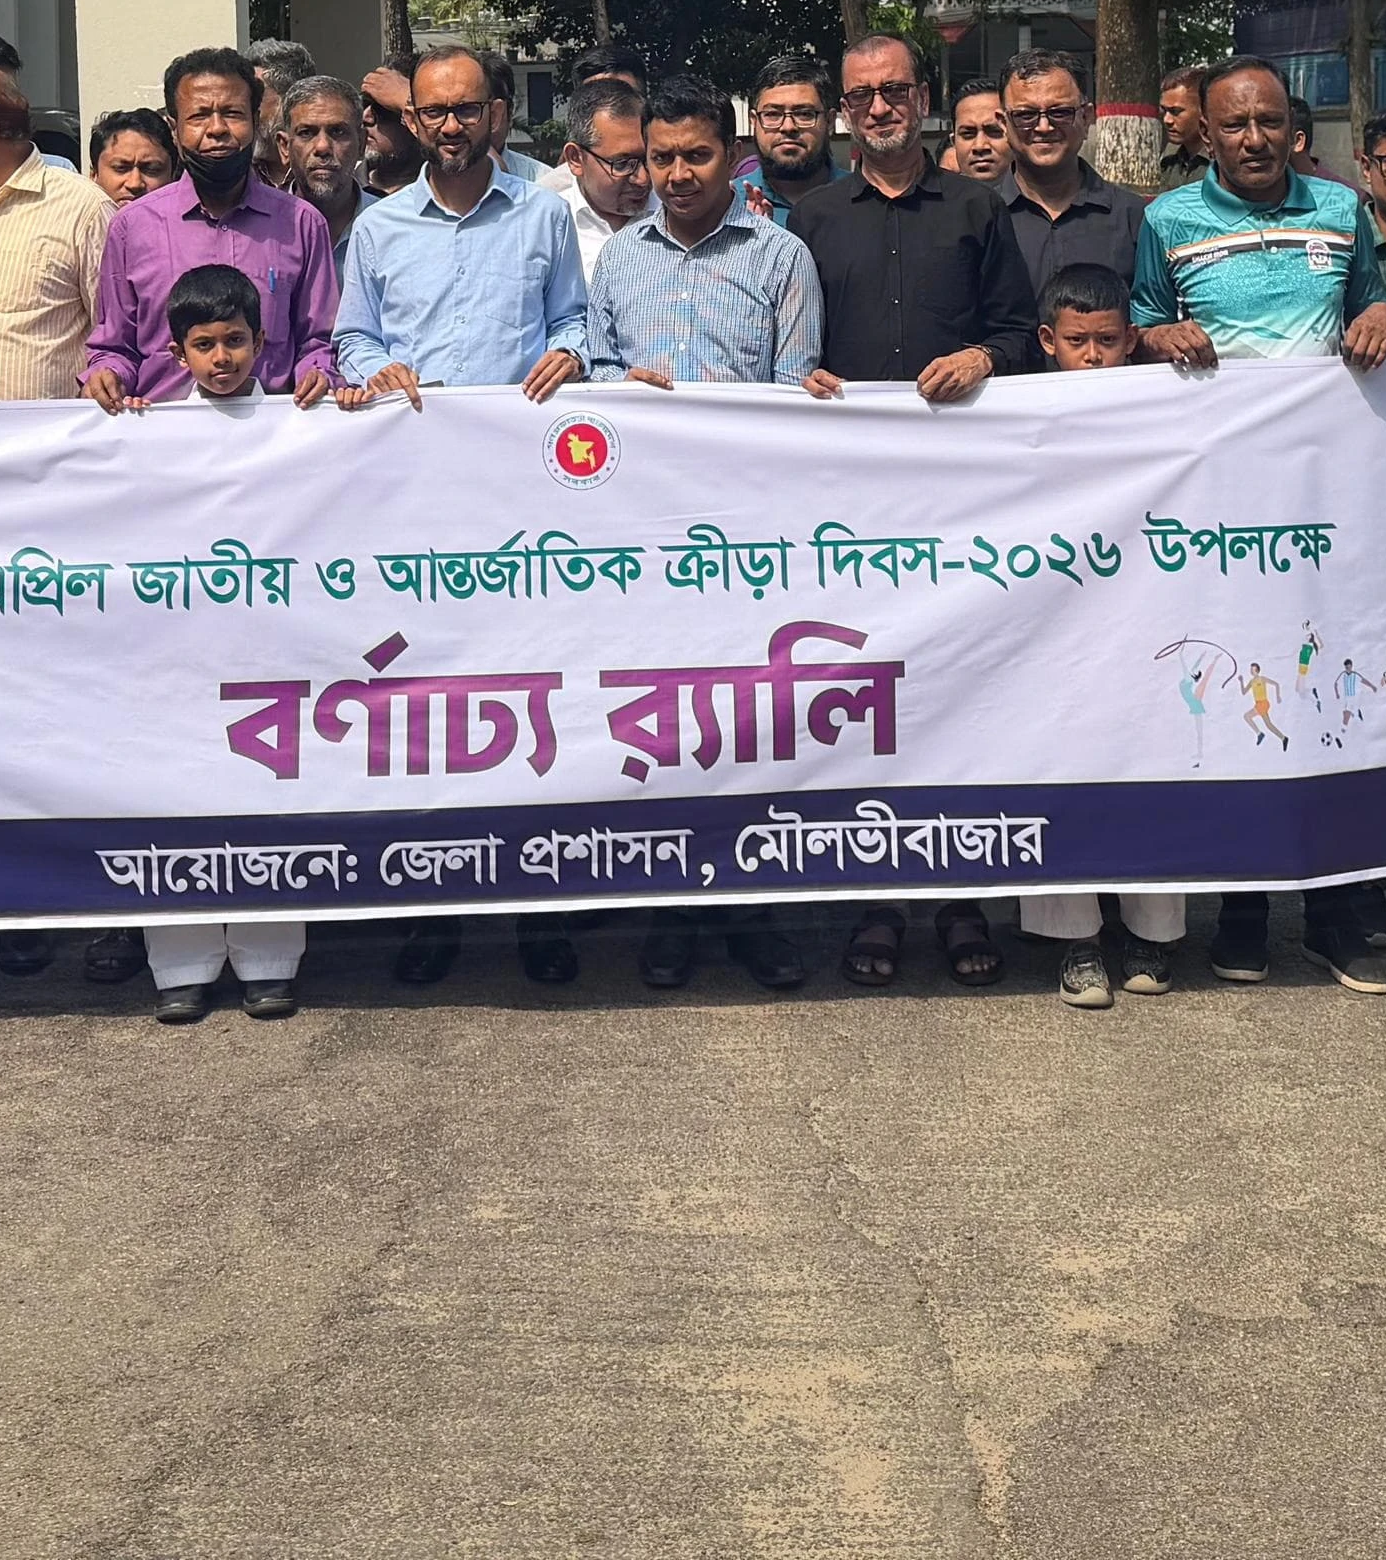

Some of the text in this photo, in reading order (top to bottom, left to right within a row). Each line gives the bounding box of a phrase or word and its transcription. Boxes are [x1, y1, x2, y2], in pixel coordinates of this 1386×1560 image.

[125, 538, 298, 610] জাতীয়
[316, 557, 357, 600] ও
[373, 530, 645, 604] আন্তর্জাতিক
[665, 524, 795, 600] ক্রীড়া
[814, 521, 1122, 592] দিবস-২০২৬
[1144, 511, 1337, 577] উপলক্ষে
[219, 631, 563, 781] বর্ণাঢ্য
[379, 833, 507, 886] জেলা
[733, 800, 1049, 875] মৌলভীবাজার
